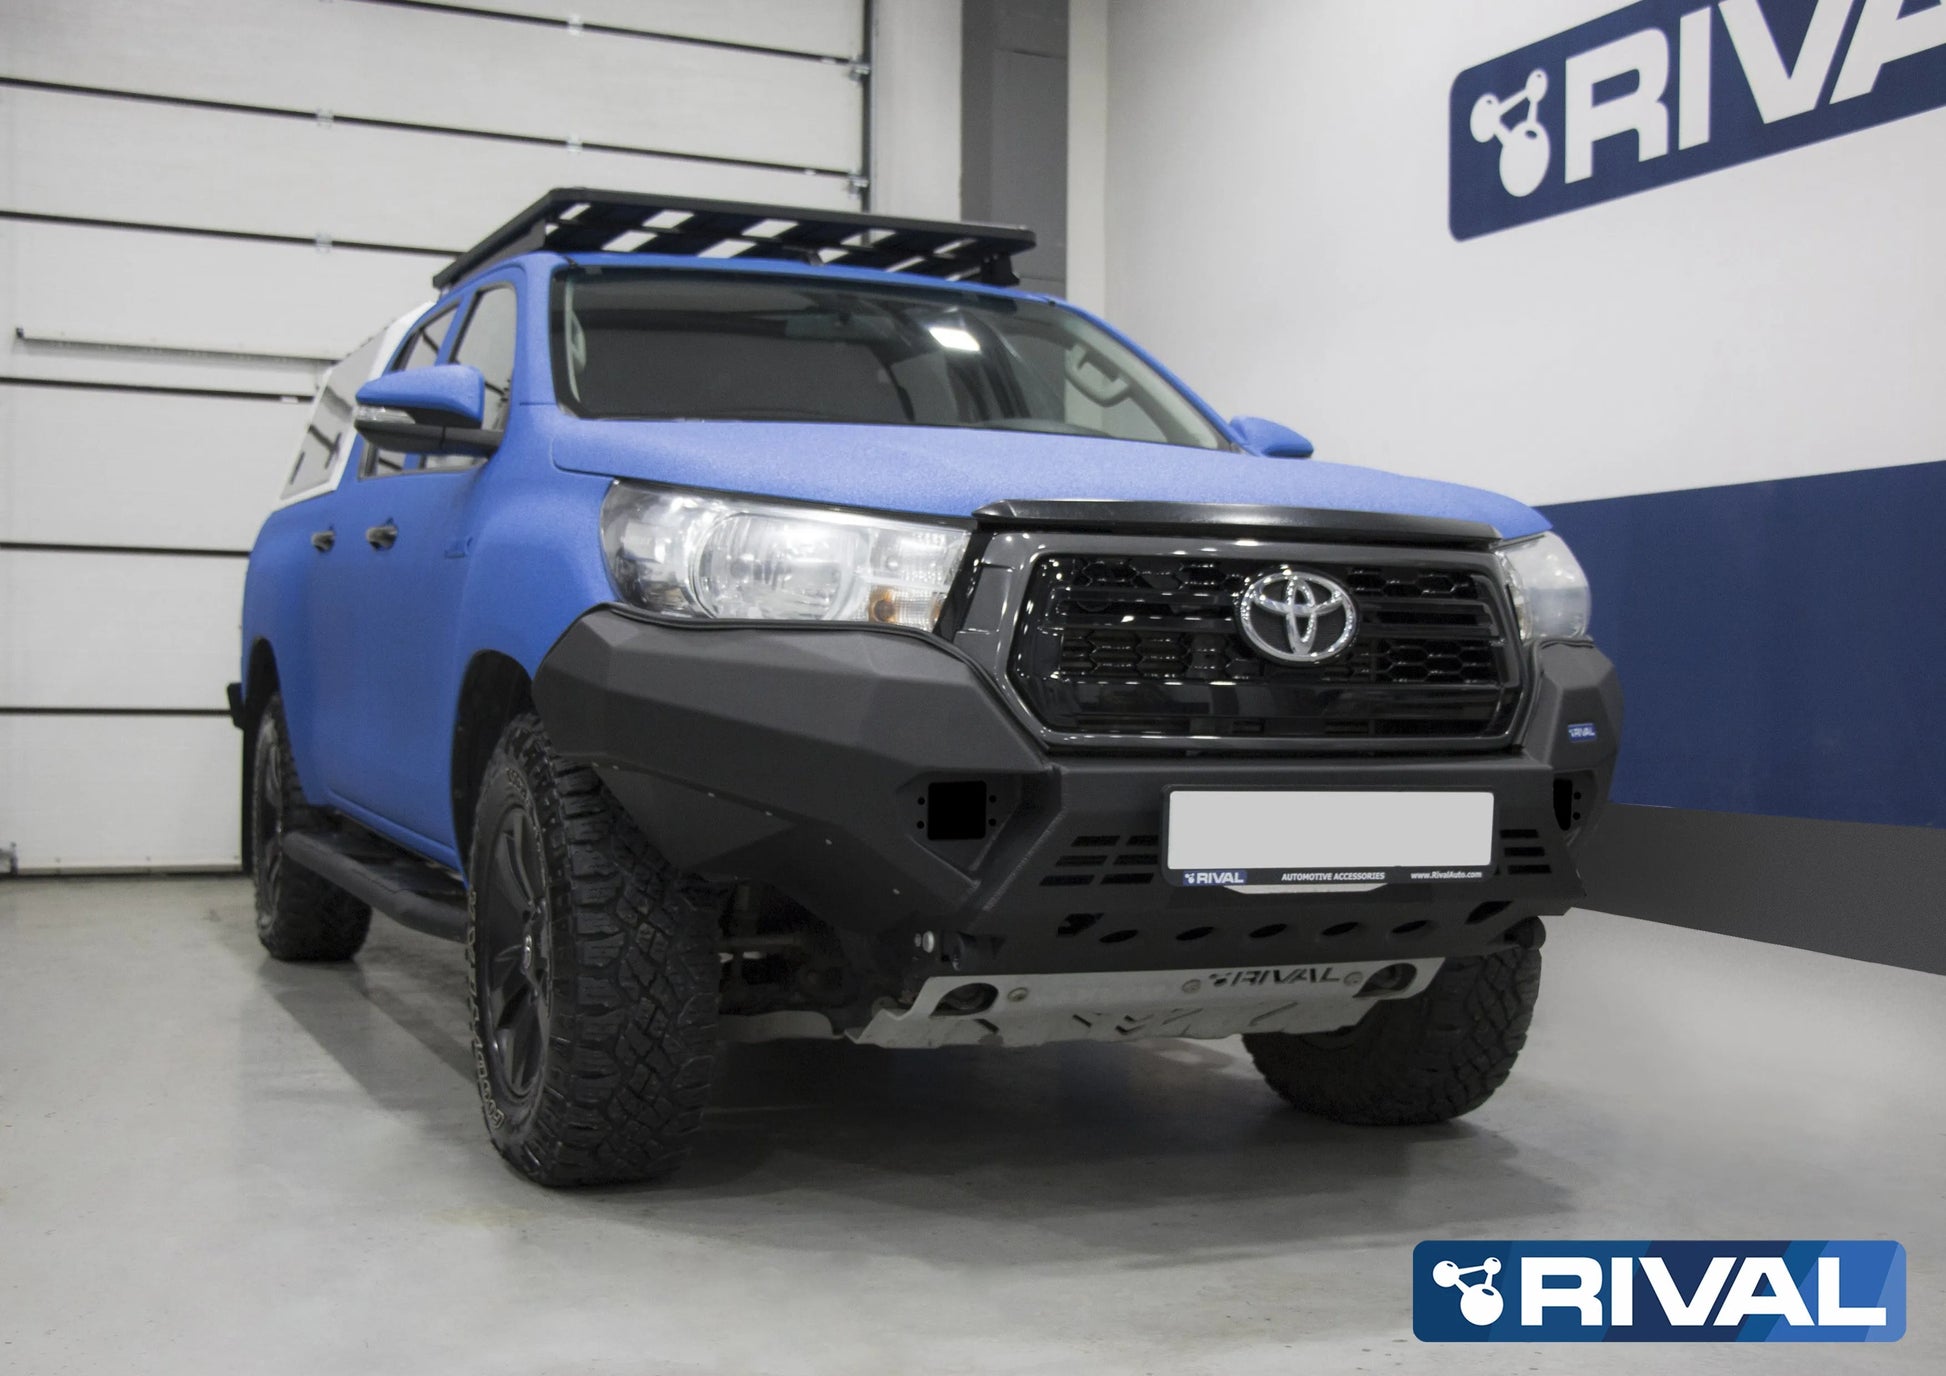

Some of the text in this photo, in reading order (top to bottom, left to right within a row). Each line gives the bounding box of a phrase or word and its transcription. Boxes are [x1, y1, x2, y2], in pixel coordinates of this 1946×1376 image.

[1196, 870, 1483, 884] RIVAL AUTOMOTIVE ACCESSORIES www.RivalAuto.com
[1231, 968, 1340, 986] RIVAL
